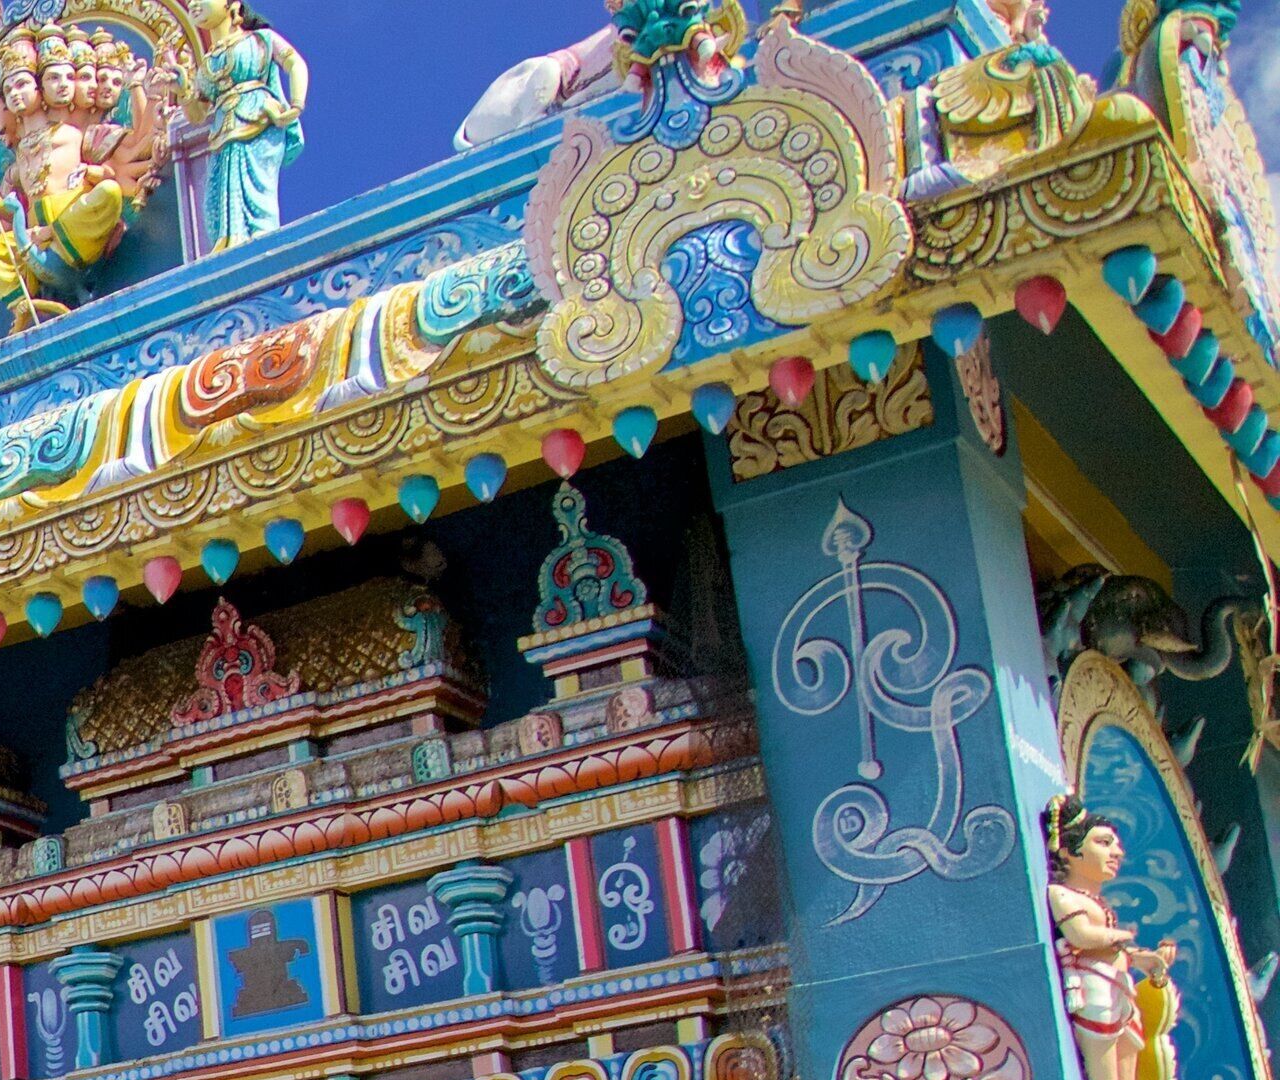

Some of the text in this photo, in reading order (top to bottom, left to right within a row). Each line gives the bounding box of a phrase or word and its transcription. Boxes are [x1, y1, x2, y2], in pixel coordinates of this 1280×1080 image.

[370, 896, 440, 951] சிவ
[127, 948, 183, 1005] சிவ
[382, 936, 458, 996] சிவ
[143, 983, 199, 1047] சிவ
